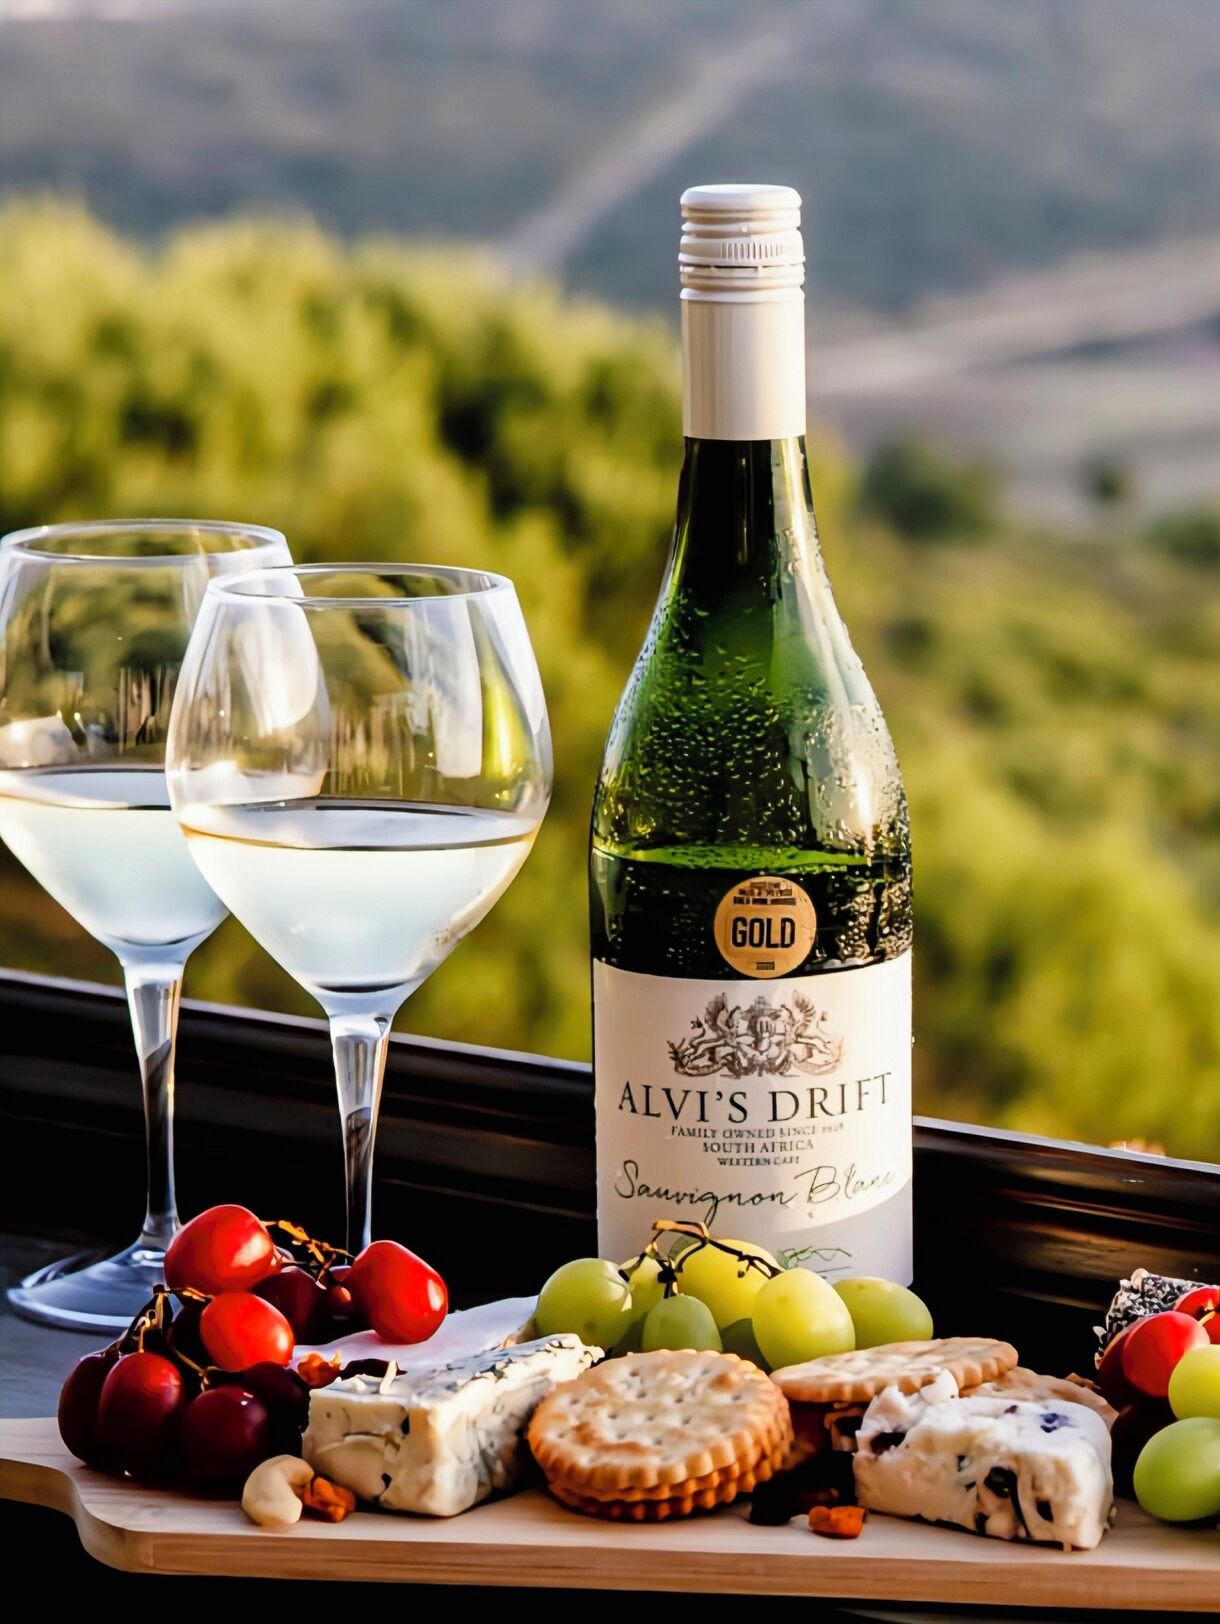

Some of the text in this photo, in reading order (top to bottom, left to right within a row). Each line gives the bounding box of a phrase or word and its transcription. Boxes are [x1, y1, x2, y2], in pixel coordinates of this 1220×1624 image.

[732, 916, 796, 949] GOLD
[618, 1072, 893, 1124] ALVI'S DRIFT
[671, 1125, 717, 1139] FAMILY
[722, 1127, 776, 1139] OWNED
[703, 1139, 814, 1154] SOUTH AFRICA
[614, 1159, 895, 1231] Sauvignon Blanc
